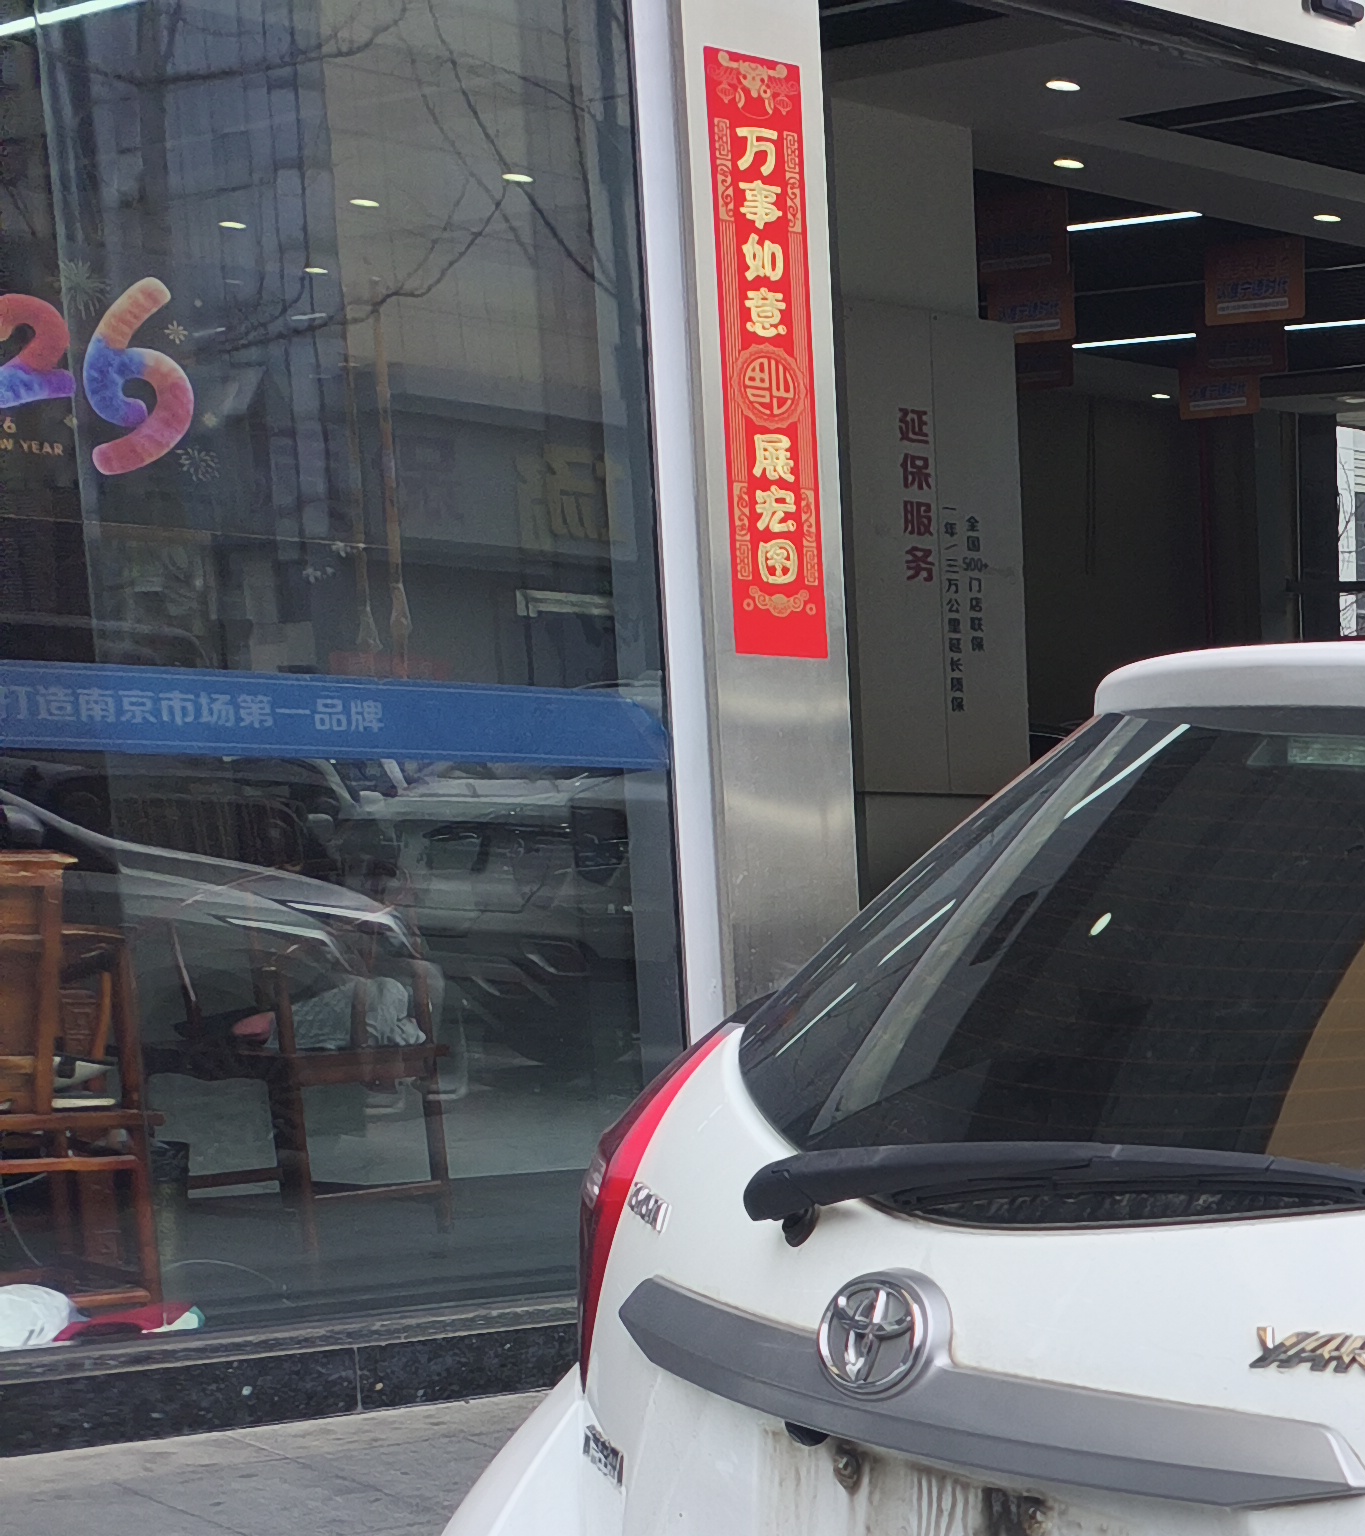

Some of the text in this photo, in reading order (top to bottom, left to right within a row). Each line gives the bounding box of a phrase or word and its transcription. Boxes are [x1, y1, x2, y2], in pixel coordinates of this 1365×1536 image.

[735, 126, 787, 338] 万事如意
[20, 439, 64, 456] YEAR
[752, 433, 799, 585] 展宏图
[898, 407, 936, 582] 延保服务
